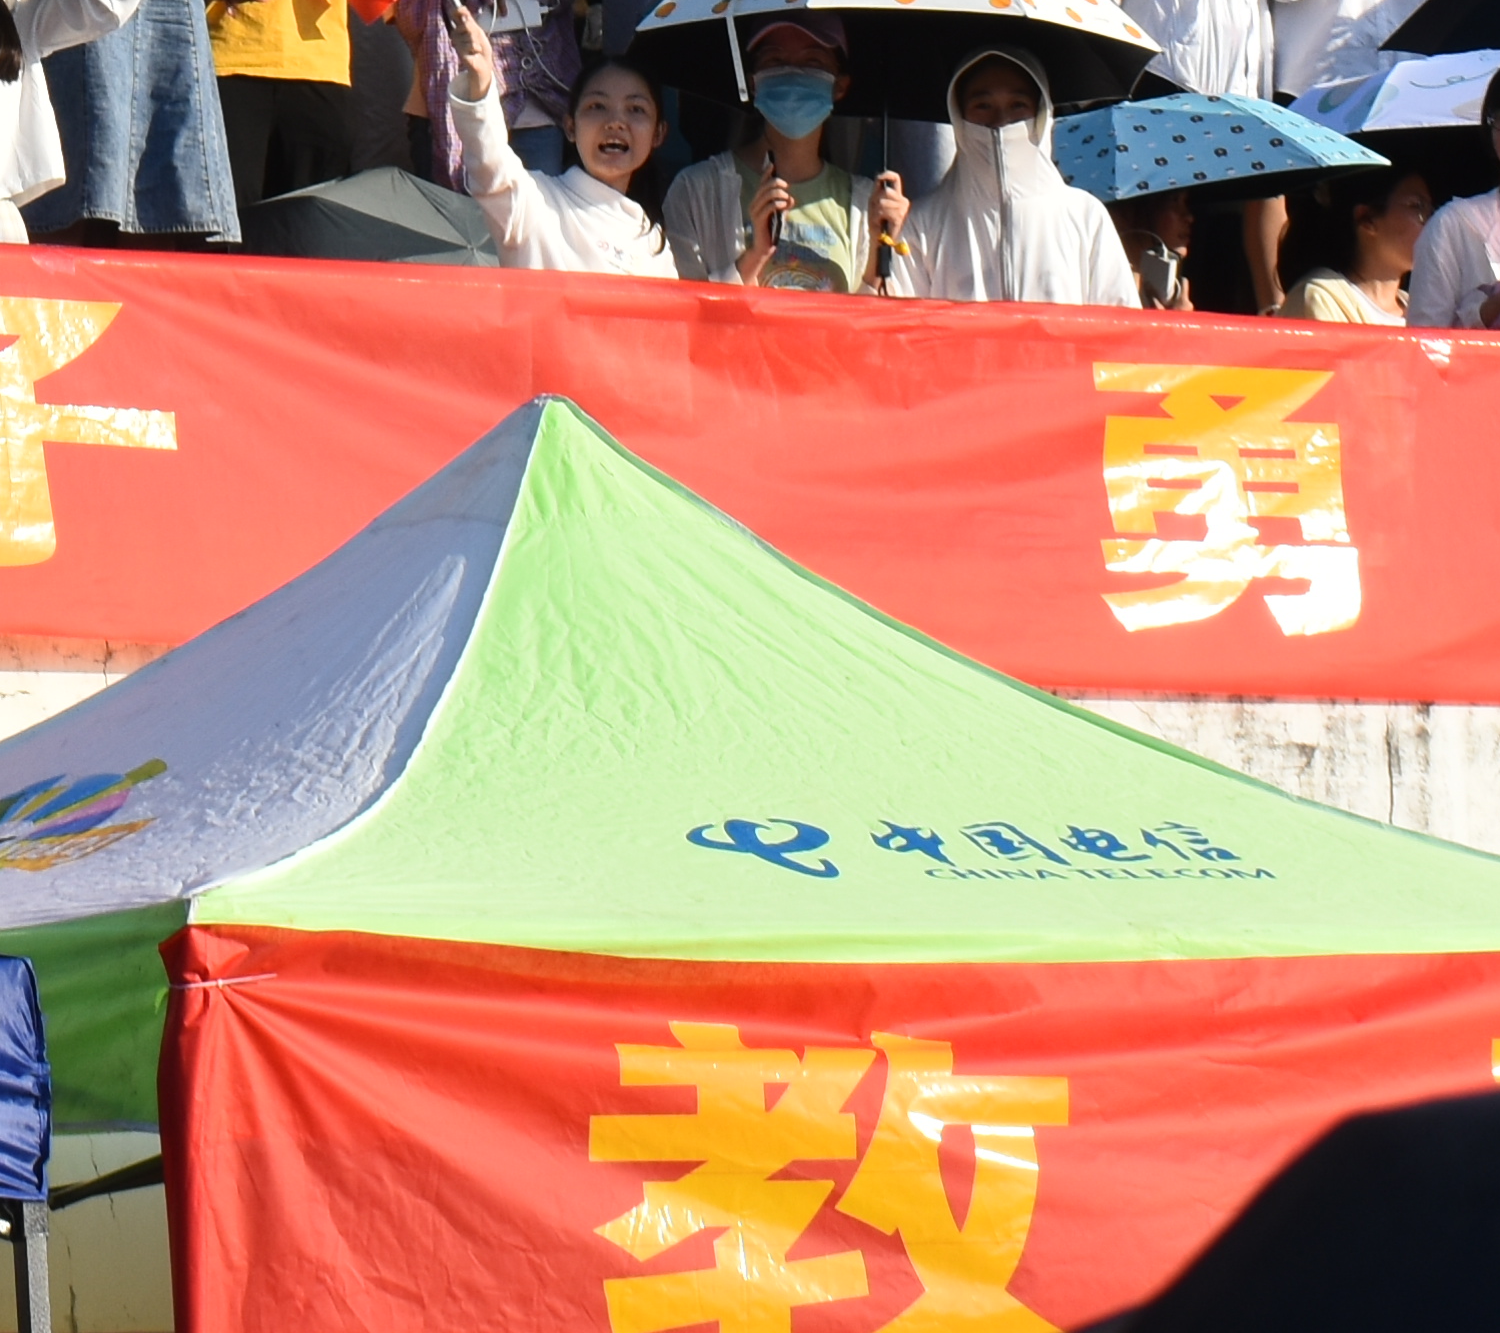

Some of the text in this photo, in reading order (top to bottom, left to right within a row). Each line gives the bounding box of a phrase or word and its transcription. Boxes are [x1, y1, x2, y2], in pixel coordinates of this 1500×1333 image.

[870, 818, 1243, 866] 中国电信
[924, 867, 1278, 880] CHINA TELECOM
